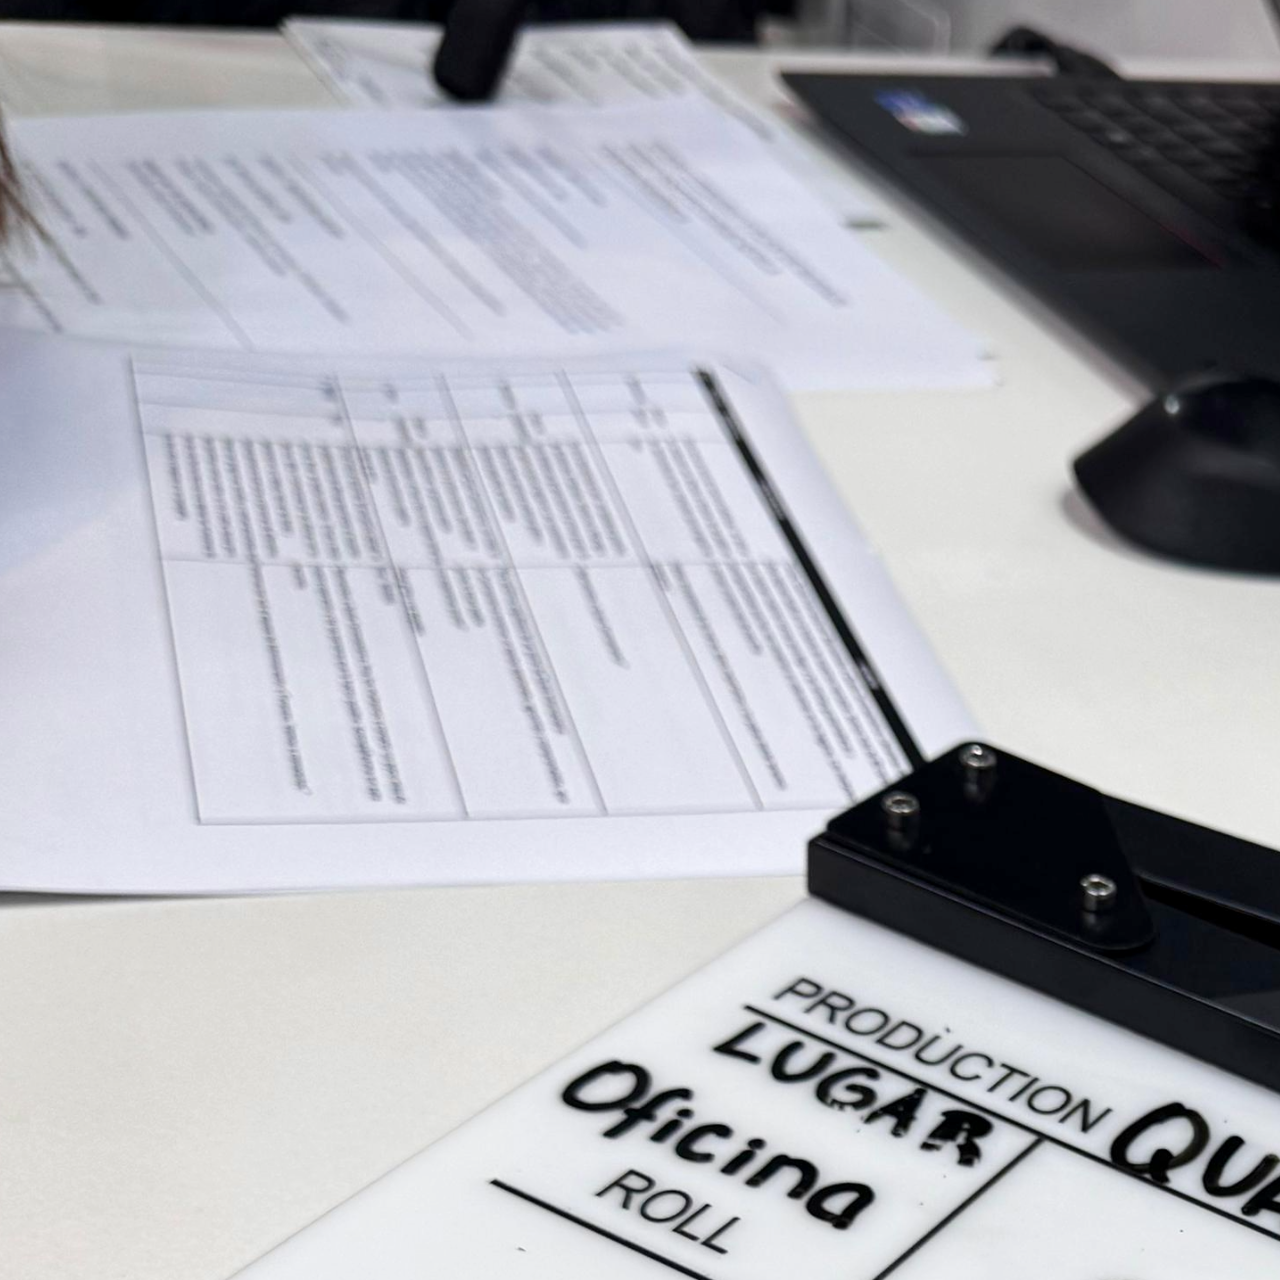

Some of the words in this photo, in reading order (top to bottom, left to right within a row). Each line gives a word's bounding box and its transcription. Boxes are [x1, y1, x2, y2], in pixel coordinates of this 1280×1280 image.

[713, 1021, 994, 1167] LUGAR
[774, 977, 1112, 1133] PRODUCTION
[561, 1060, 876, 1229] Oficina
[595, 1168, 742, 1254] ROLL
